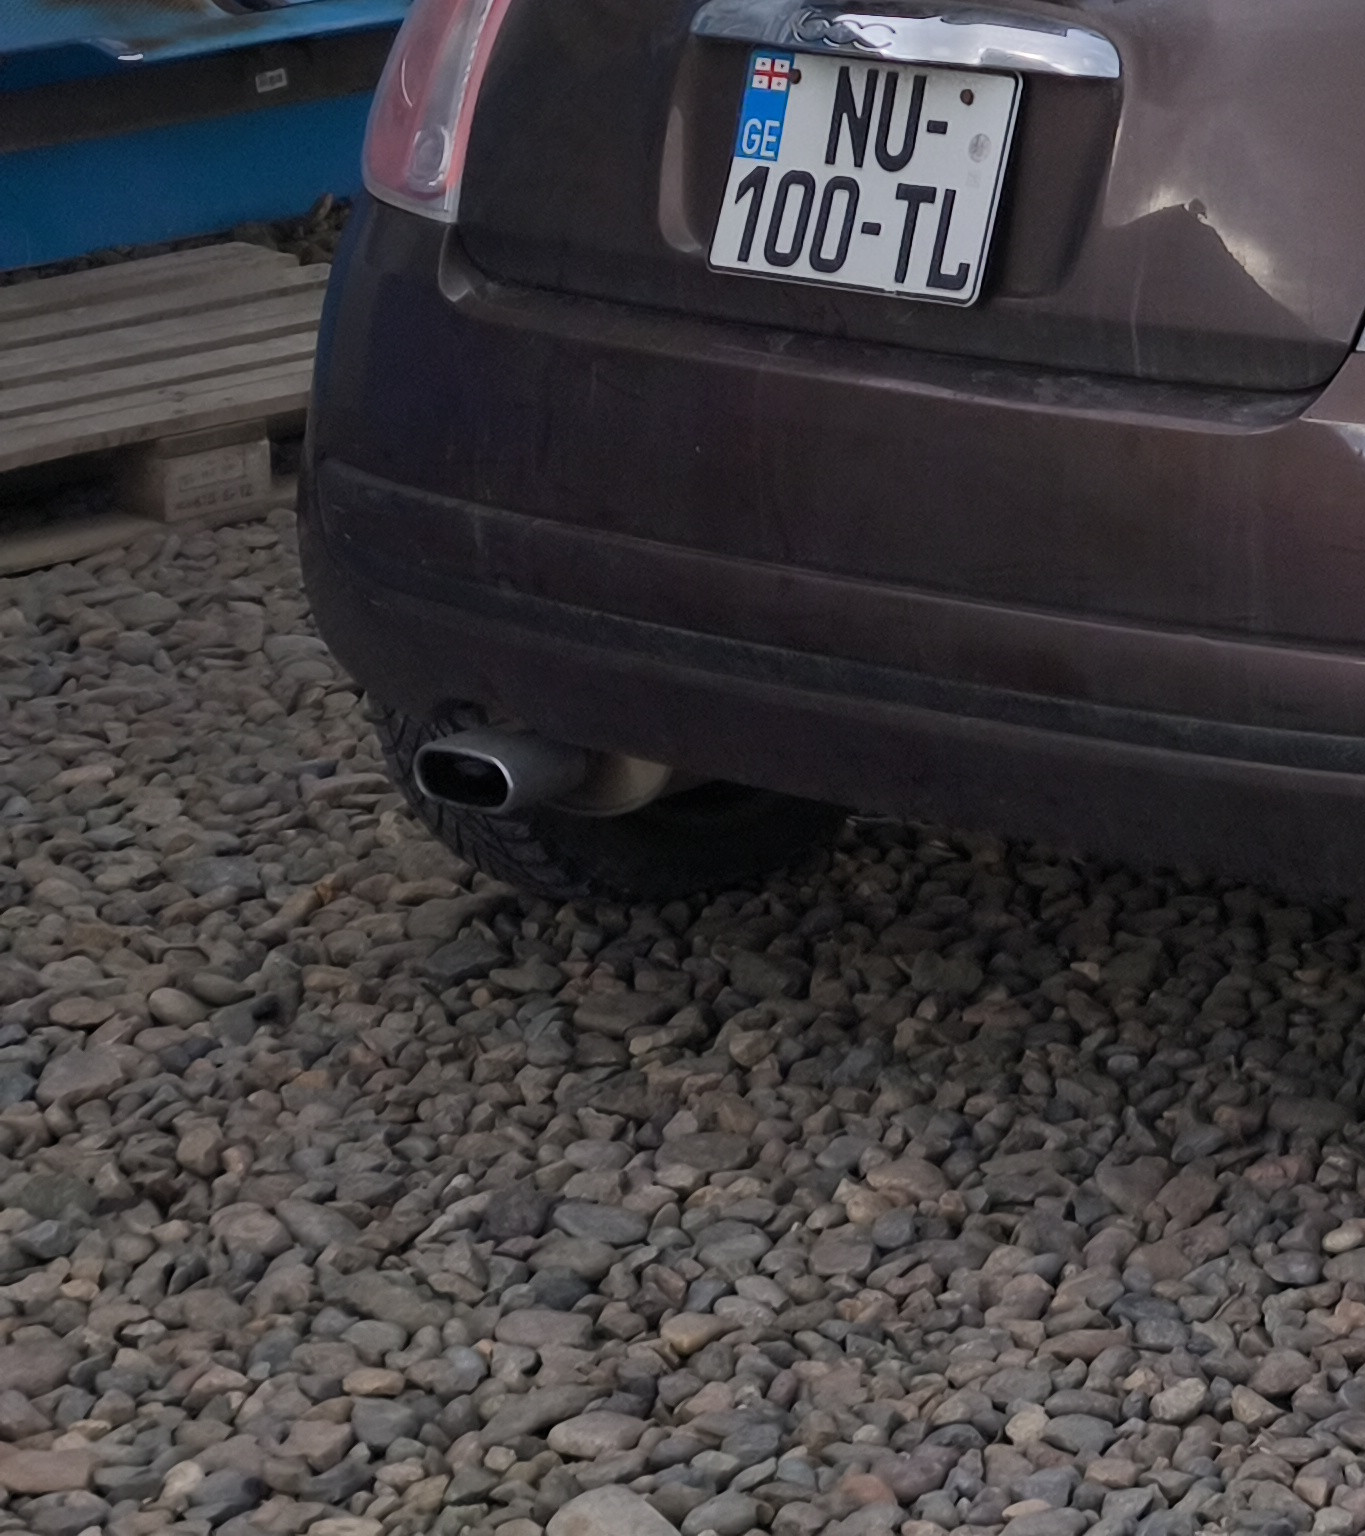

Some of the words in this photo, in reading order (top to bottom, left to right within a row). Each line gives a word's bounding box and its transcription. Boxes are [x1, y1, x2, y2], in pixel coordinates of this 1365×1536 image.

[741, 118, 781, 158] GE
[824, 65, 948, 172] NU-
[734, 165, 971, 291] 100-TL
